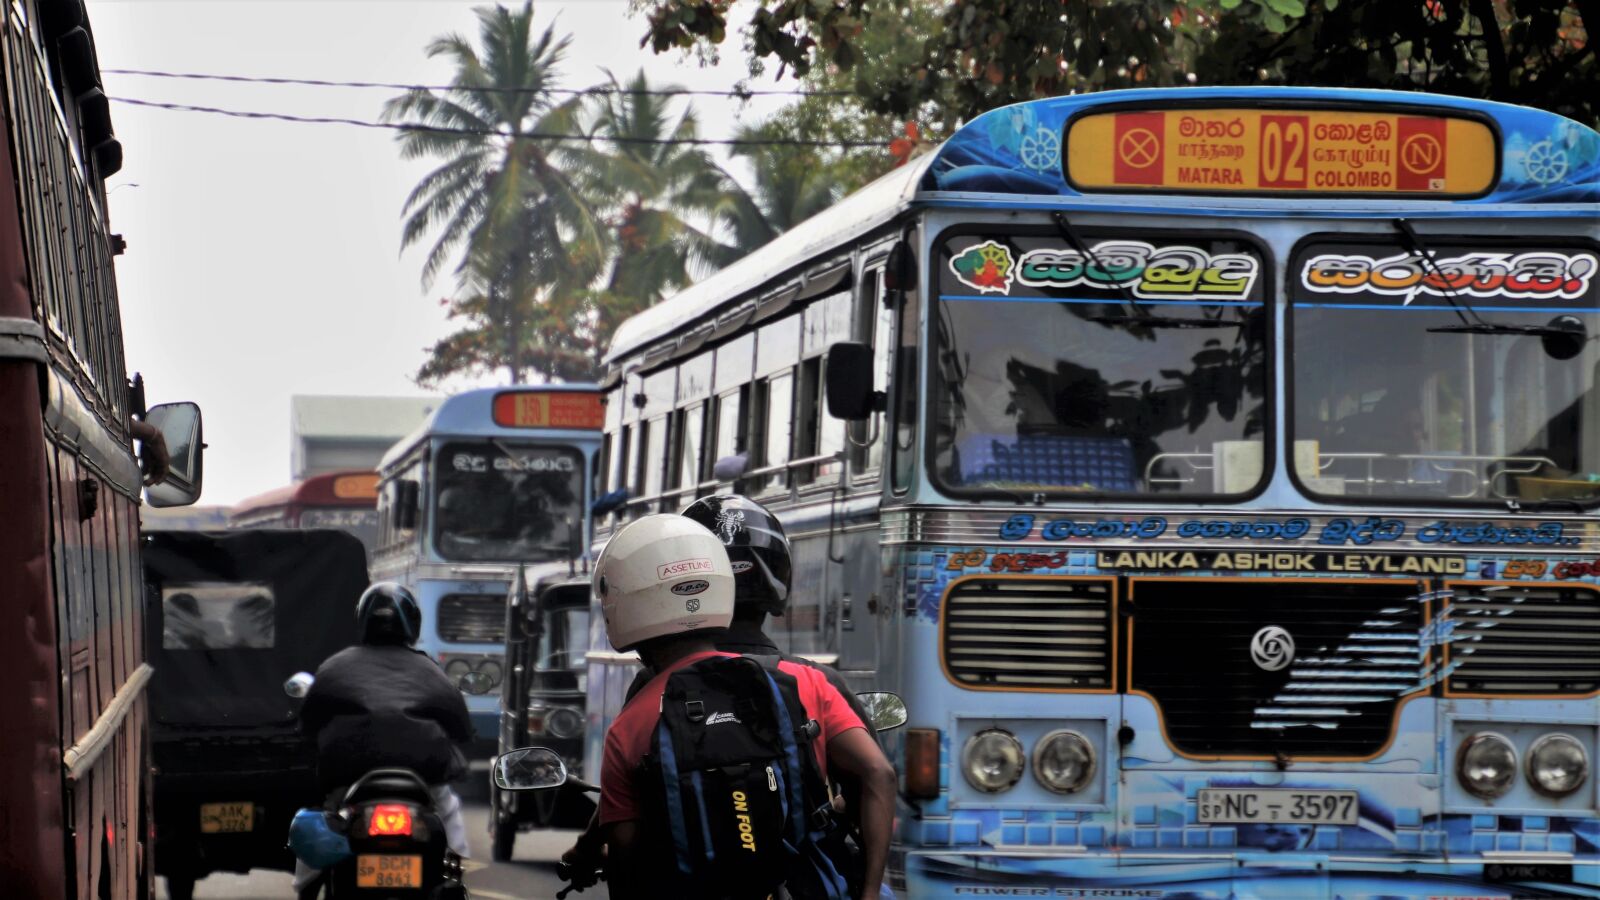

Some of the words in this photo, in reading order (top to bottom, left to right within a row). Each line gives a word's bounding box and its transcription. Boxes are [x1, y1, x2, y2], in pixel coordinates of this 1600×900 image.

[1179, 116, 1245, 138] මාතර
[1313, 120, 1391, 144] කොළඹ
[1262, 121, 1305, 183] 02
[1313, 144, 1390, 168] கொழும்பு
[1178, 166, 1244, 184] MATARA
[1314, 171, 1392, 187] COLOMBO
[663, 560, 713, 576] ASSETLINE
[1097, 552, 1199, 569] LANKA
[1211, 553, 1315, 571] ASHOK
[1326, 554, 1466, 575] LEYLAND
[732, 791, 748, 812] ON
[1225, 794, 1259, 818] NC
[1289, 795, 1354, 819] 3597
[736, 815, 756, 852] FOOT
[360, 866, 375, 876] SP
[955, 886, 1048, 896] POWER
[1056, 887, 1163, 898] STROKE
